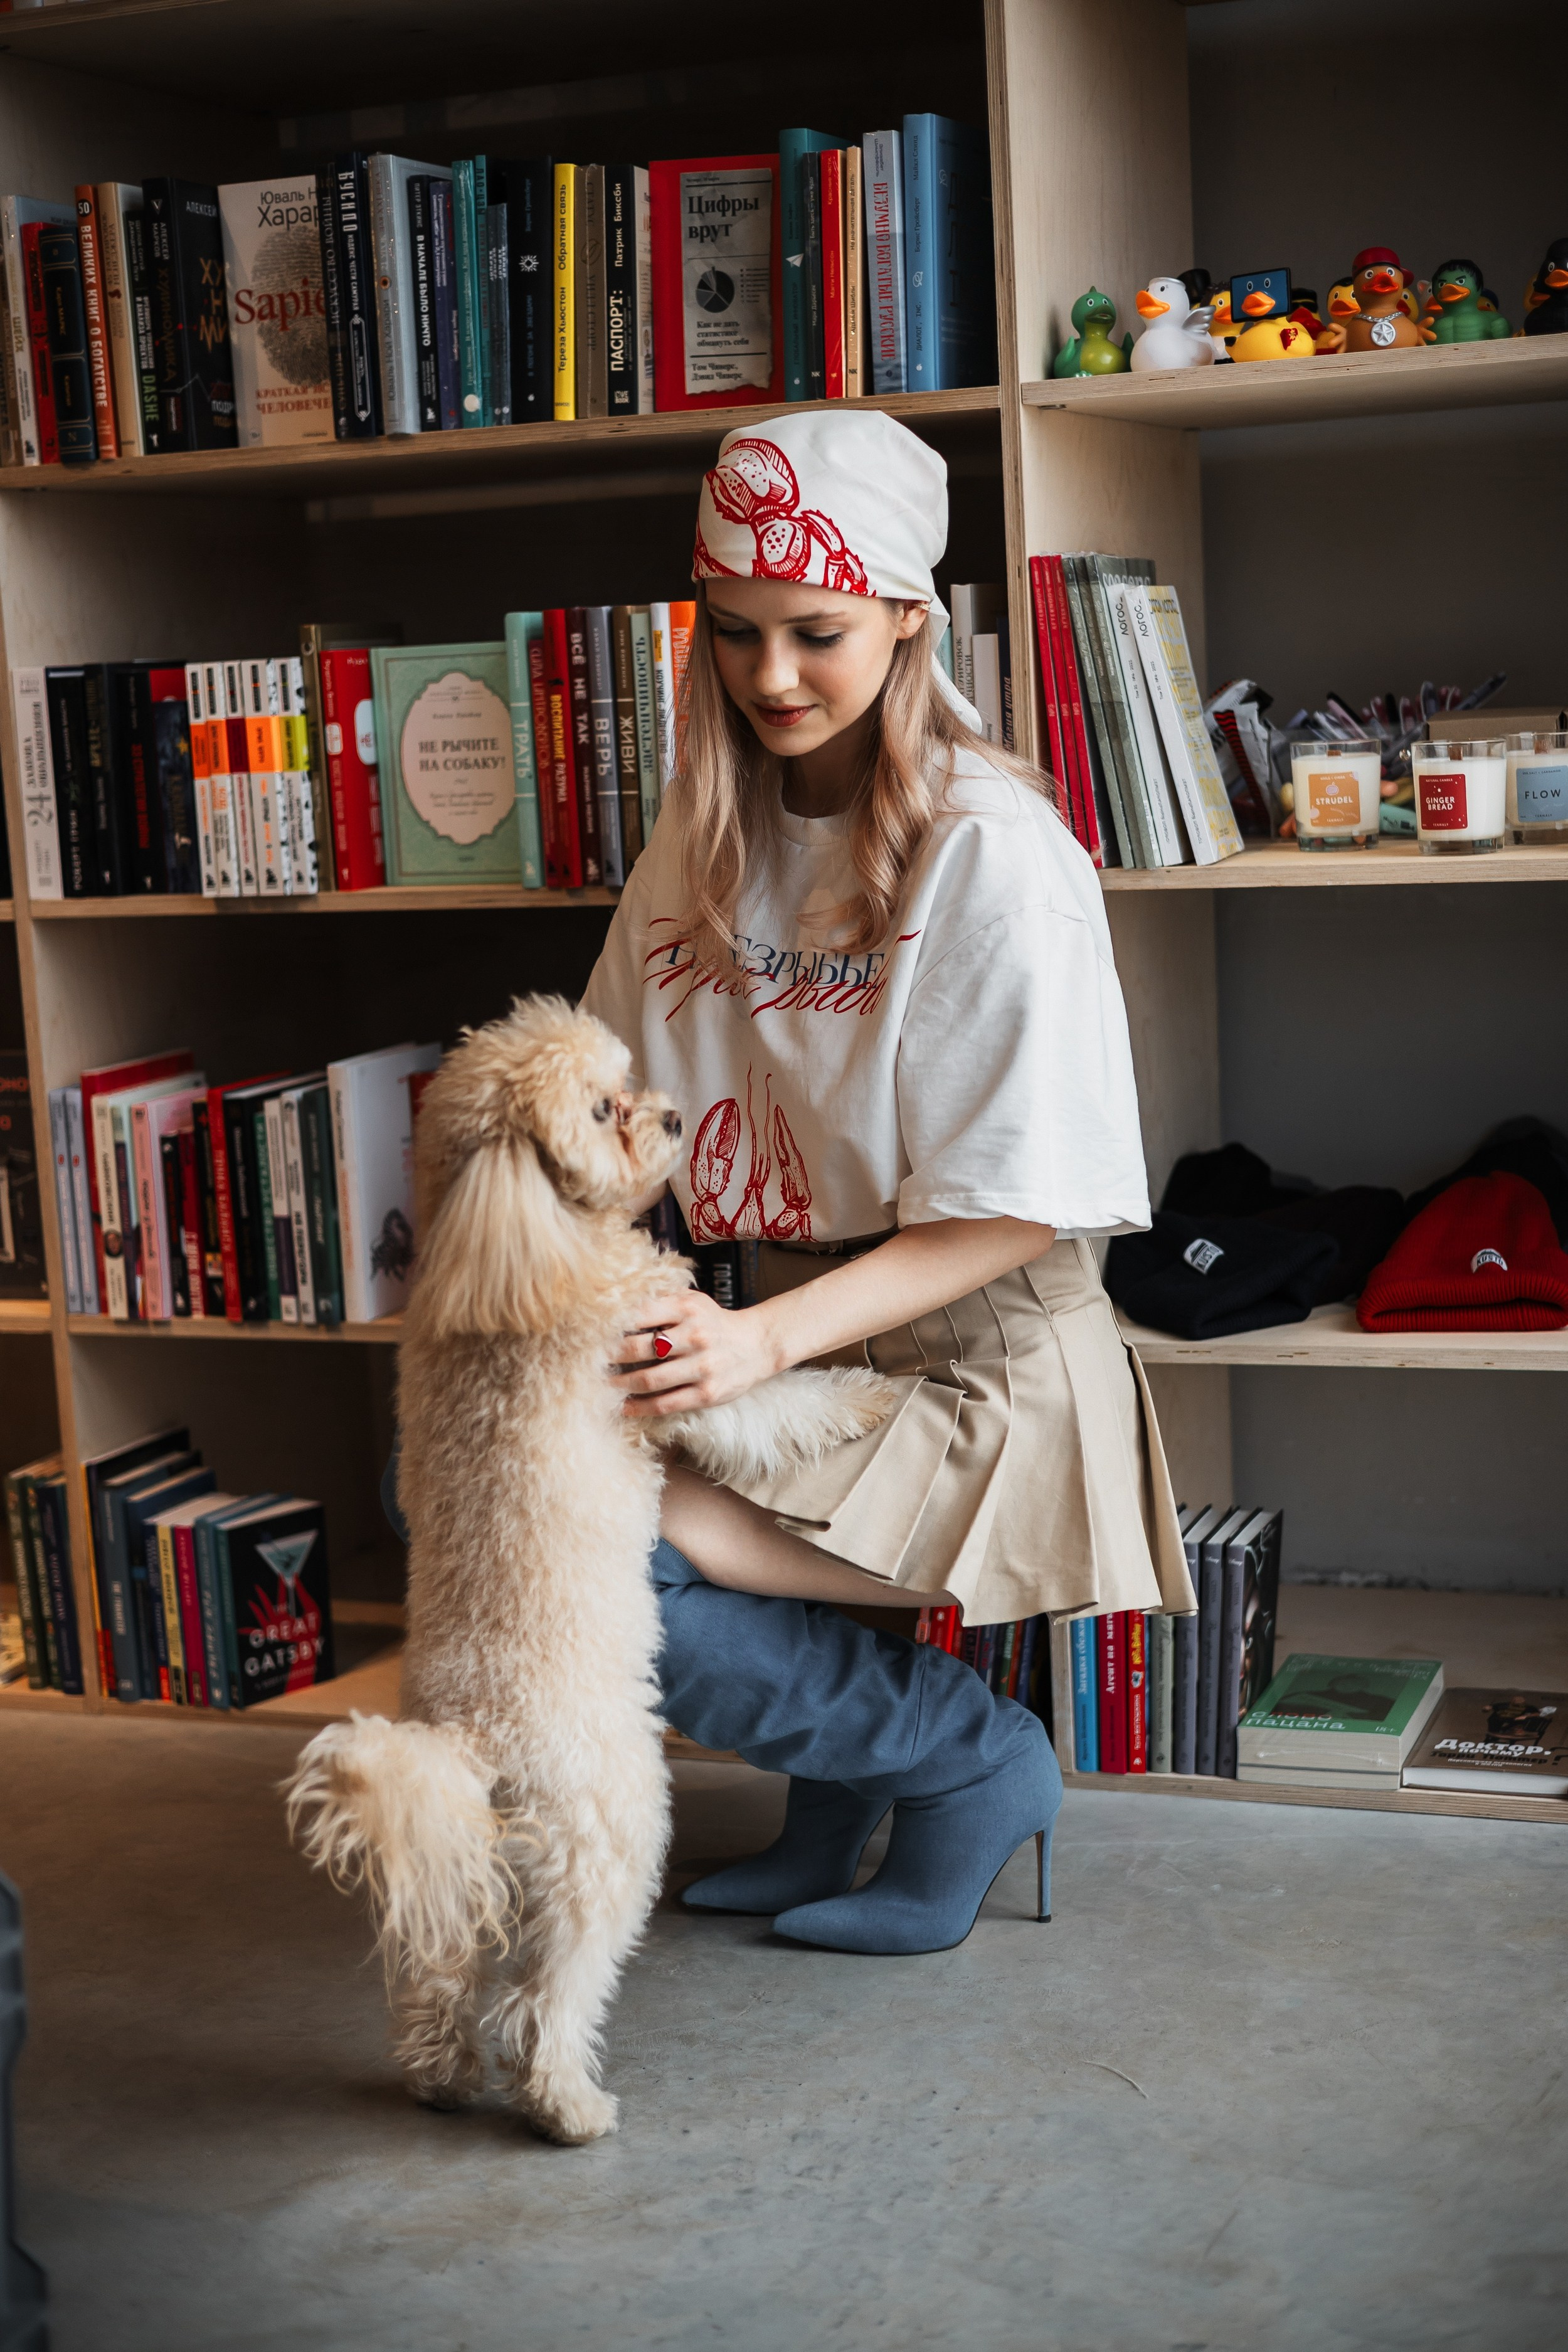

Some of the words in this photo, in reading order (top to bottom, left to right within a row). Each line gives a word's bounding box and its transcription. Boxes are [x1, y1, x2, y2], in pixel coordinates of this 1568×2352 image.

[77, 202, 90, 214] 50
[260, 190, 305, 206] Юваль
[558, 184, 566, 215] связь
[613, 183, 622, 222] Биксби
[687, 194, 760, 217] Цифры
[873, 181, 890, 241] БЕЗУМНО
[257, 204, 319, 231] Хара
[322, 195, 335, 245] ВОЙНЫ
[687, 223, 733, 243] врут
[80, 225, 97, 283] ВЕЛИКИХ
[153, 222, 161, 258] МАРКОВ
[160, 222, 170, 260] АЛЕКСЕЙ
[347, 234, 356, 259] КОДЕКС
[558, 218, 568, 270] Обратная
[614, 227, 625, 267] Патрик
[349, 260, 358, 280] ЧЕСТИ
[417, 243, 427, 282] НАЧАЛЕ
[876, 245, 893, 302] БОГАТЫЕ
[87, 289, 100, 320] КНИГ
[234, 276, 327, 332] Sapie
[327, 250, 341, 324] ИСКУССТВО
[351, 281, 360, 311] САМУРАЯ
[419, 283, 429, 312] БЫЛО
[558, 287, 566, 333] Хьюстон
[697, 320, 712, 329] Как
[90, 327, 102, 336] О
[421, 314, 431, 347] НИЧТО
[610, 290, 624, 371] ПАСПОРТ:
[879, 305, 896, 361] РУССКИЕ
[558, 336, 567, 373] Тереза
[91, 340, 107, 408] БОГАТСТВЕ
[256, 383, 309, 400] КРАТКАЯ
[142, 374, 159, 423] DASHE
[257, 397, 332, 415] ЧЕЛОВЕЧЕ
[1035, 587, 1045, 630] AFTERNOON
[1046, 586, 1057, 630] AFTERNOON
[956, 637, 965, 695] АТУИРОВОК
[573, 677, 587, 701] НЕ
[1004, 676, 1012, 709] утра
[549, 694, 566, 760] ВОСПИТАНИЕ
[576, 712, 590, 745] ТАК
[618, 715, 636, 773] ЖИВИ
[418, 741, 438, 753] НЕ
[441, 737, 499, 753] РЫЧИТЕ
[514, 720, 530, 779] ТРАТЬ
[594, 717, 612, 777] ВЕРЬ
[419, 758, 440, 772] НА
[442, 756, 506, 771] СОБАКУ!
[554, 762, 568, 803] РАЗУМА
[1525, 788, 1561, 800] FLOW
[25, 792, 53, 827] 24
[1316, 796, 1353, 806] STRUDEL
[731, 934, 885, 990] ЕЗРЫБЬЕ
[248, 1611, 319, 1650] GREAT
[1106, 1612, 1115, 1640] мягк
[243, 1635, 325, 1678] GATSBY
[1106, 1645, 1115, 1660] на
[1105, 1661, 1115, 1694] Агент
[1246, 1717, 1346, 1730] пацана
[1434, 1738, 1552, 1756] Доктор,
[1458, 1747, 1525, 1757] почему
